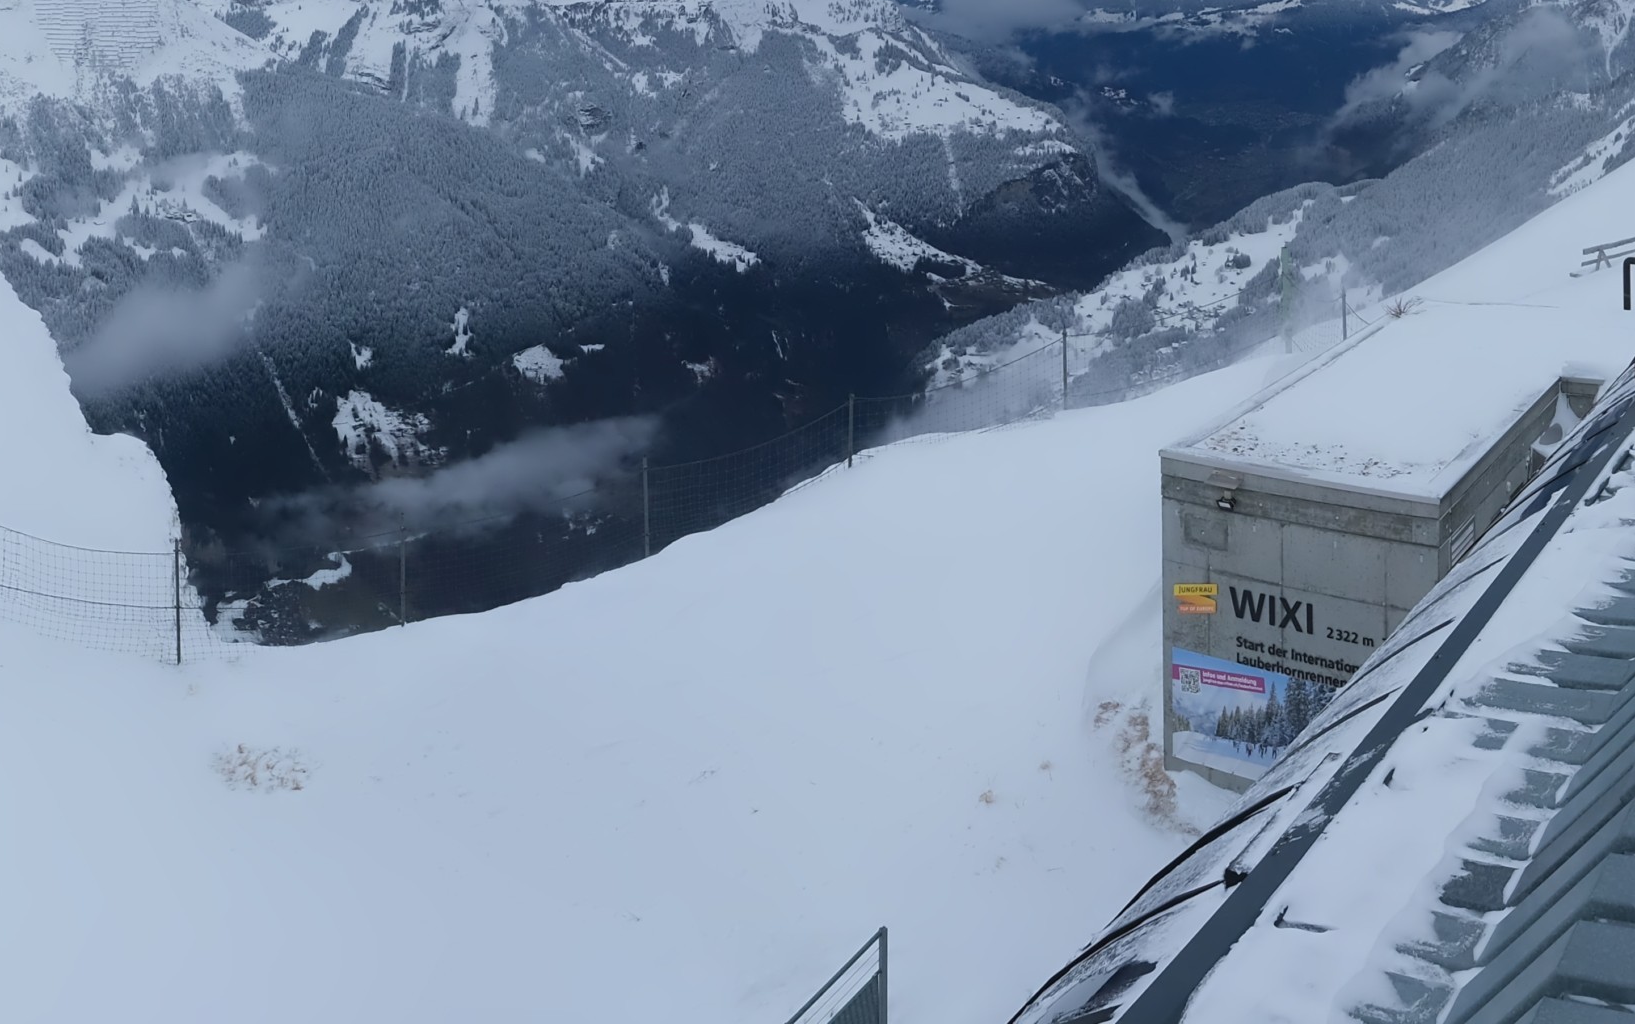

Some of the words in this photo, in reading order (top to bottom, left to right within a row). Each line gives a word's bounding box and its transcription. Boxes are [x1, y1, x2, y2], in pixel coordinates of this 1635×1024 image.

[1178, 586, 1213, 594] JUNGFRAU
[1229, 586, 1314, 635] WIXI
[1236, 636, 1265, 653] Start
[1268, 644, 1288, 658] der
[1362, 636, 1375, 647] m
